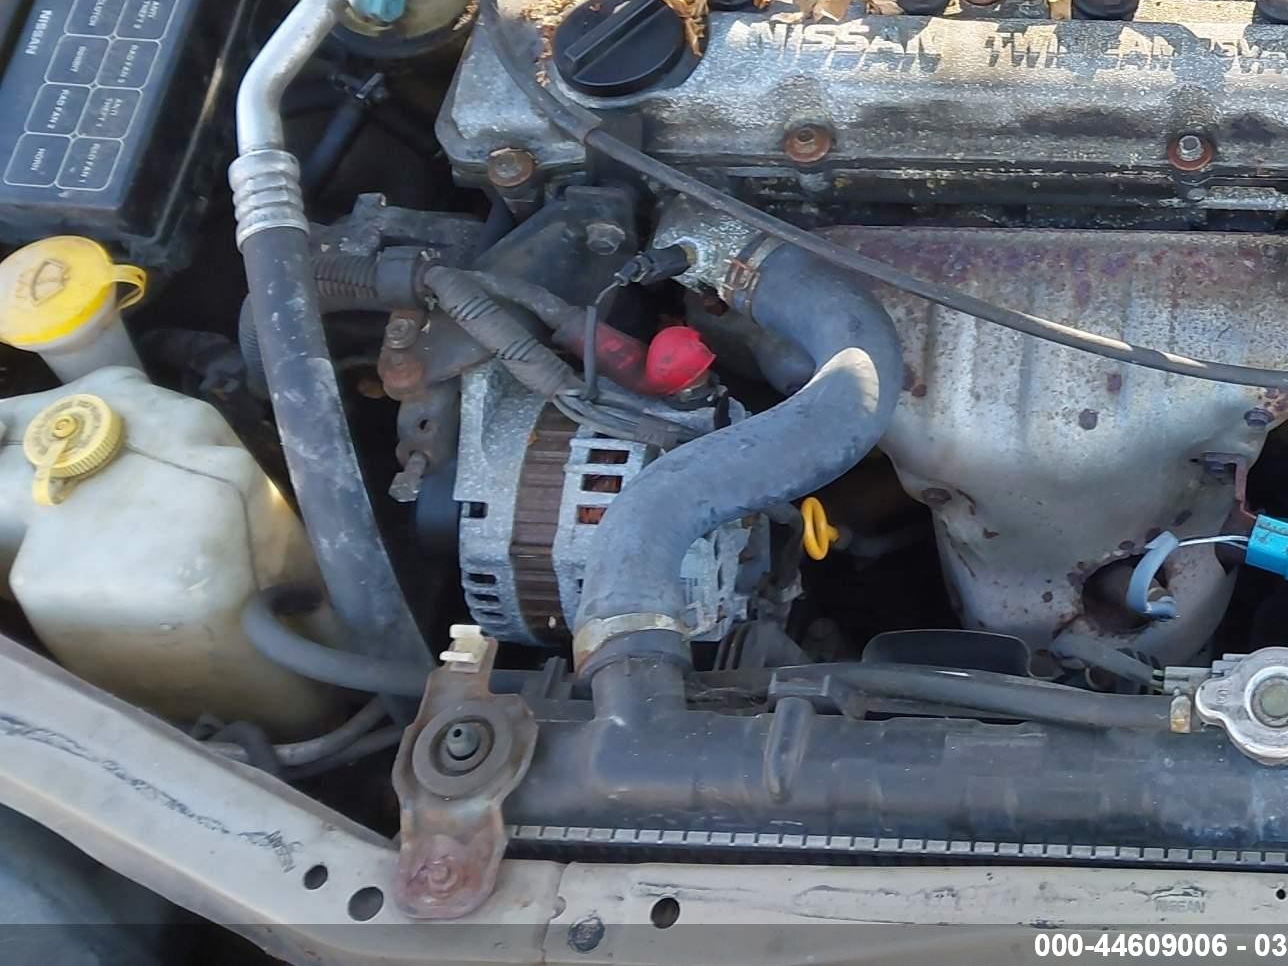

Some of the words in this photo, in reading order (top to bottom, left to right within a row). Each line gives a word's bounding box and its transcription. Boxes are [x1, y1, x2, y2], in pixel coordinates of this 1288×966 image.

[147, 0, 160, 18] ANTI
[24, 9, 53, 55] NISSAN
[748, 21, 941, 68] NISSAN
[49, 106, 64, 122] FAN
[109, 98, 123, 116] ANTI
[29, 147, 46, 171] HORN
[81, 161, 94, 177] FAN
